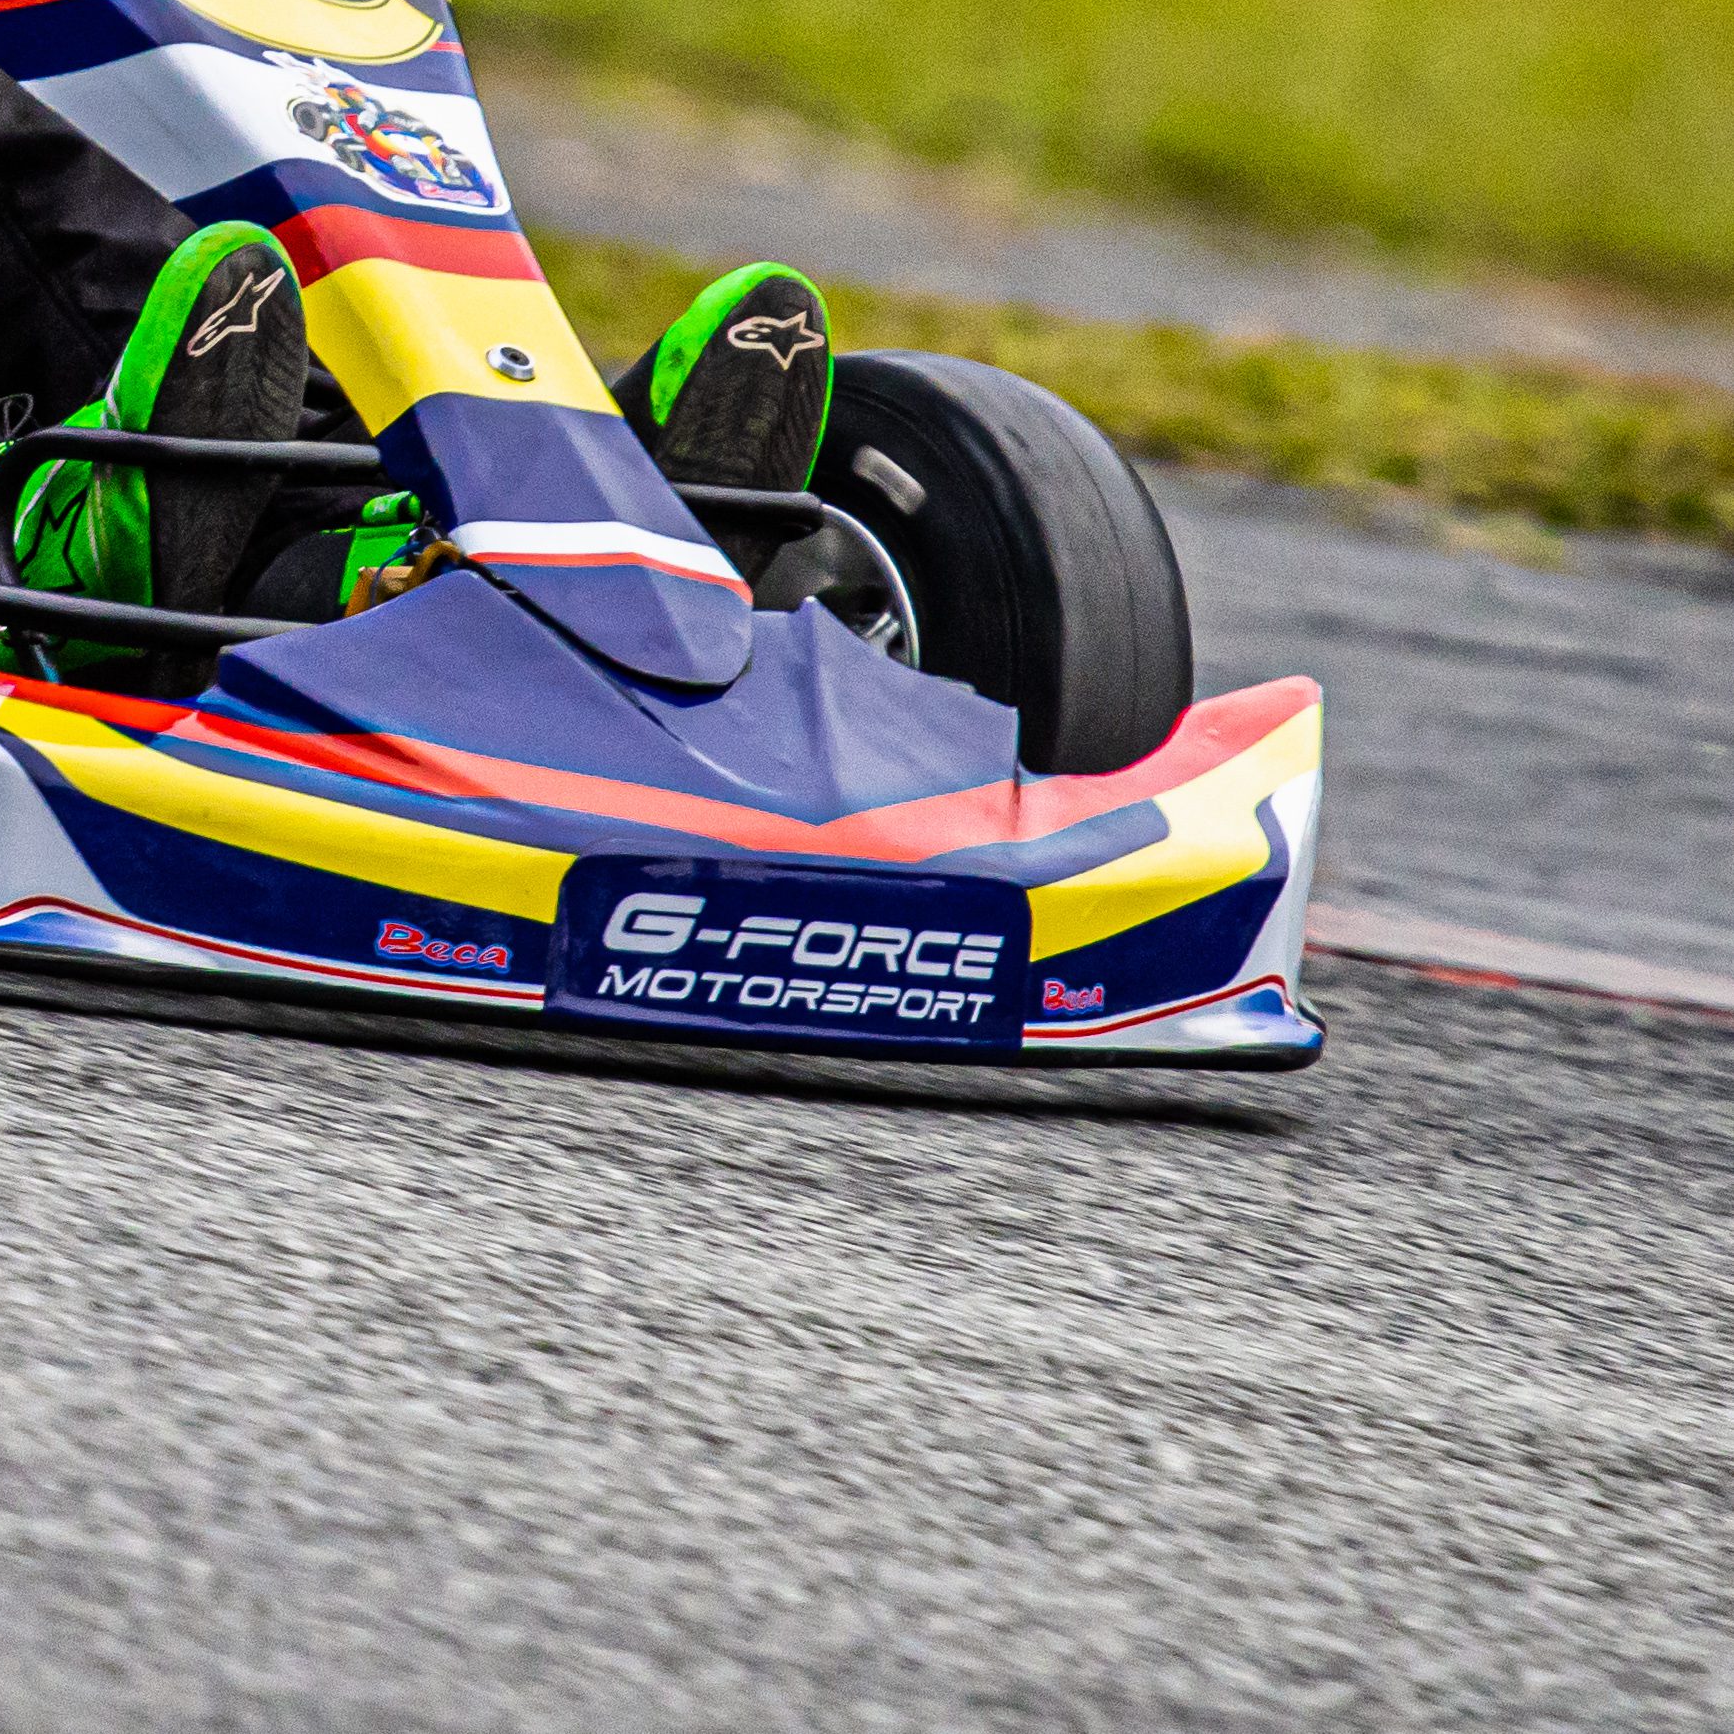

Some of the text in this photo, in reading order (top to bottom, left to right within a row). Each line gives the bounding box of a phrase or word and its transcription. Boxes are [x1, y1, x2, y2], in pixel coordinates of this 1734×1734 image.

[376, 920, 511, 973] Beca
[602, 892, 1005, 980] G-FORCE
[596, 965, 995, 1024] MOTORSPORT
